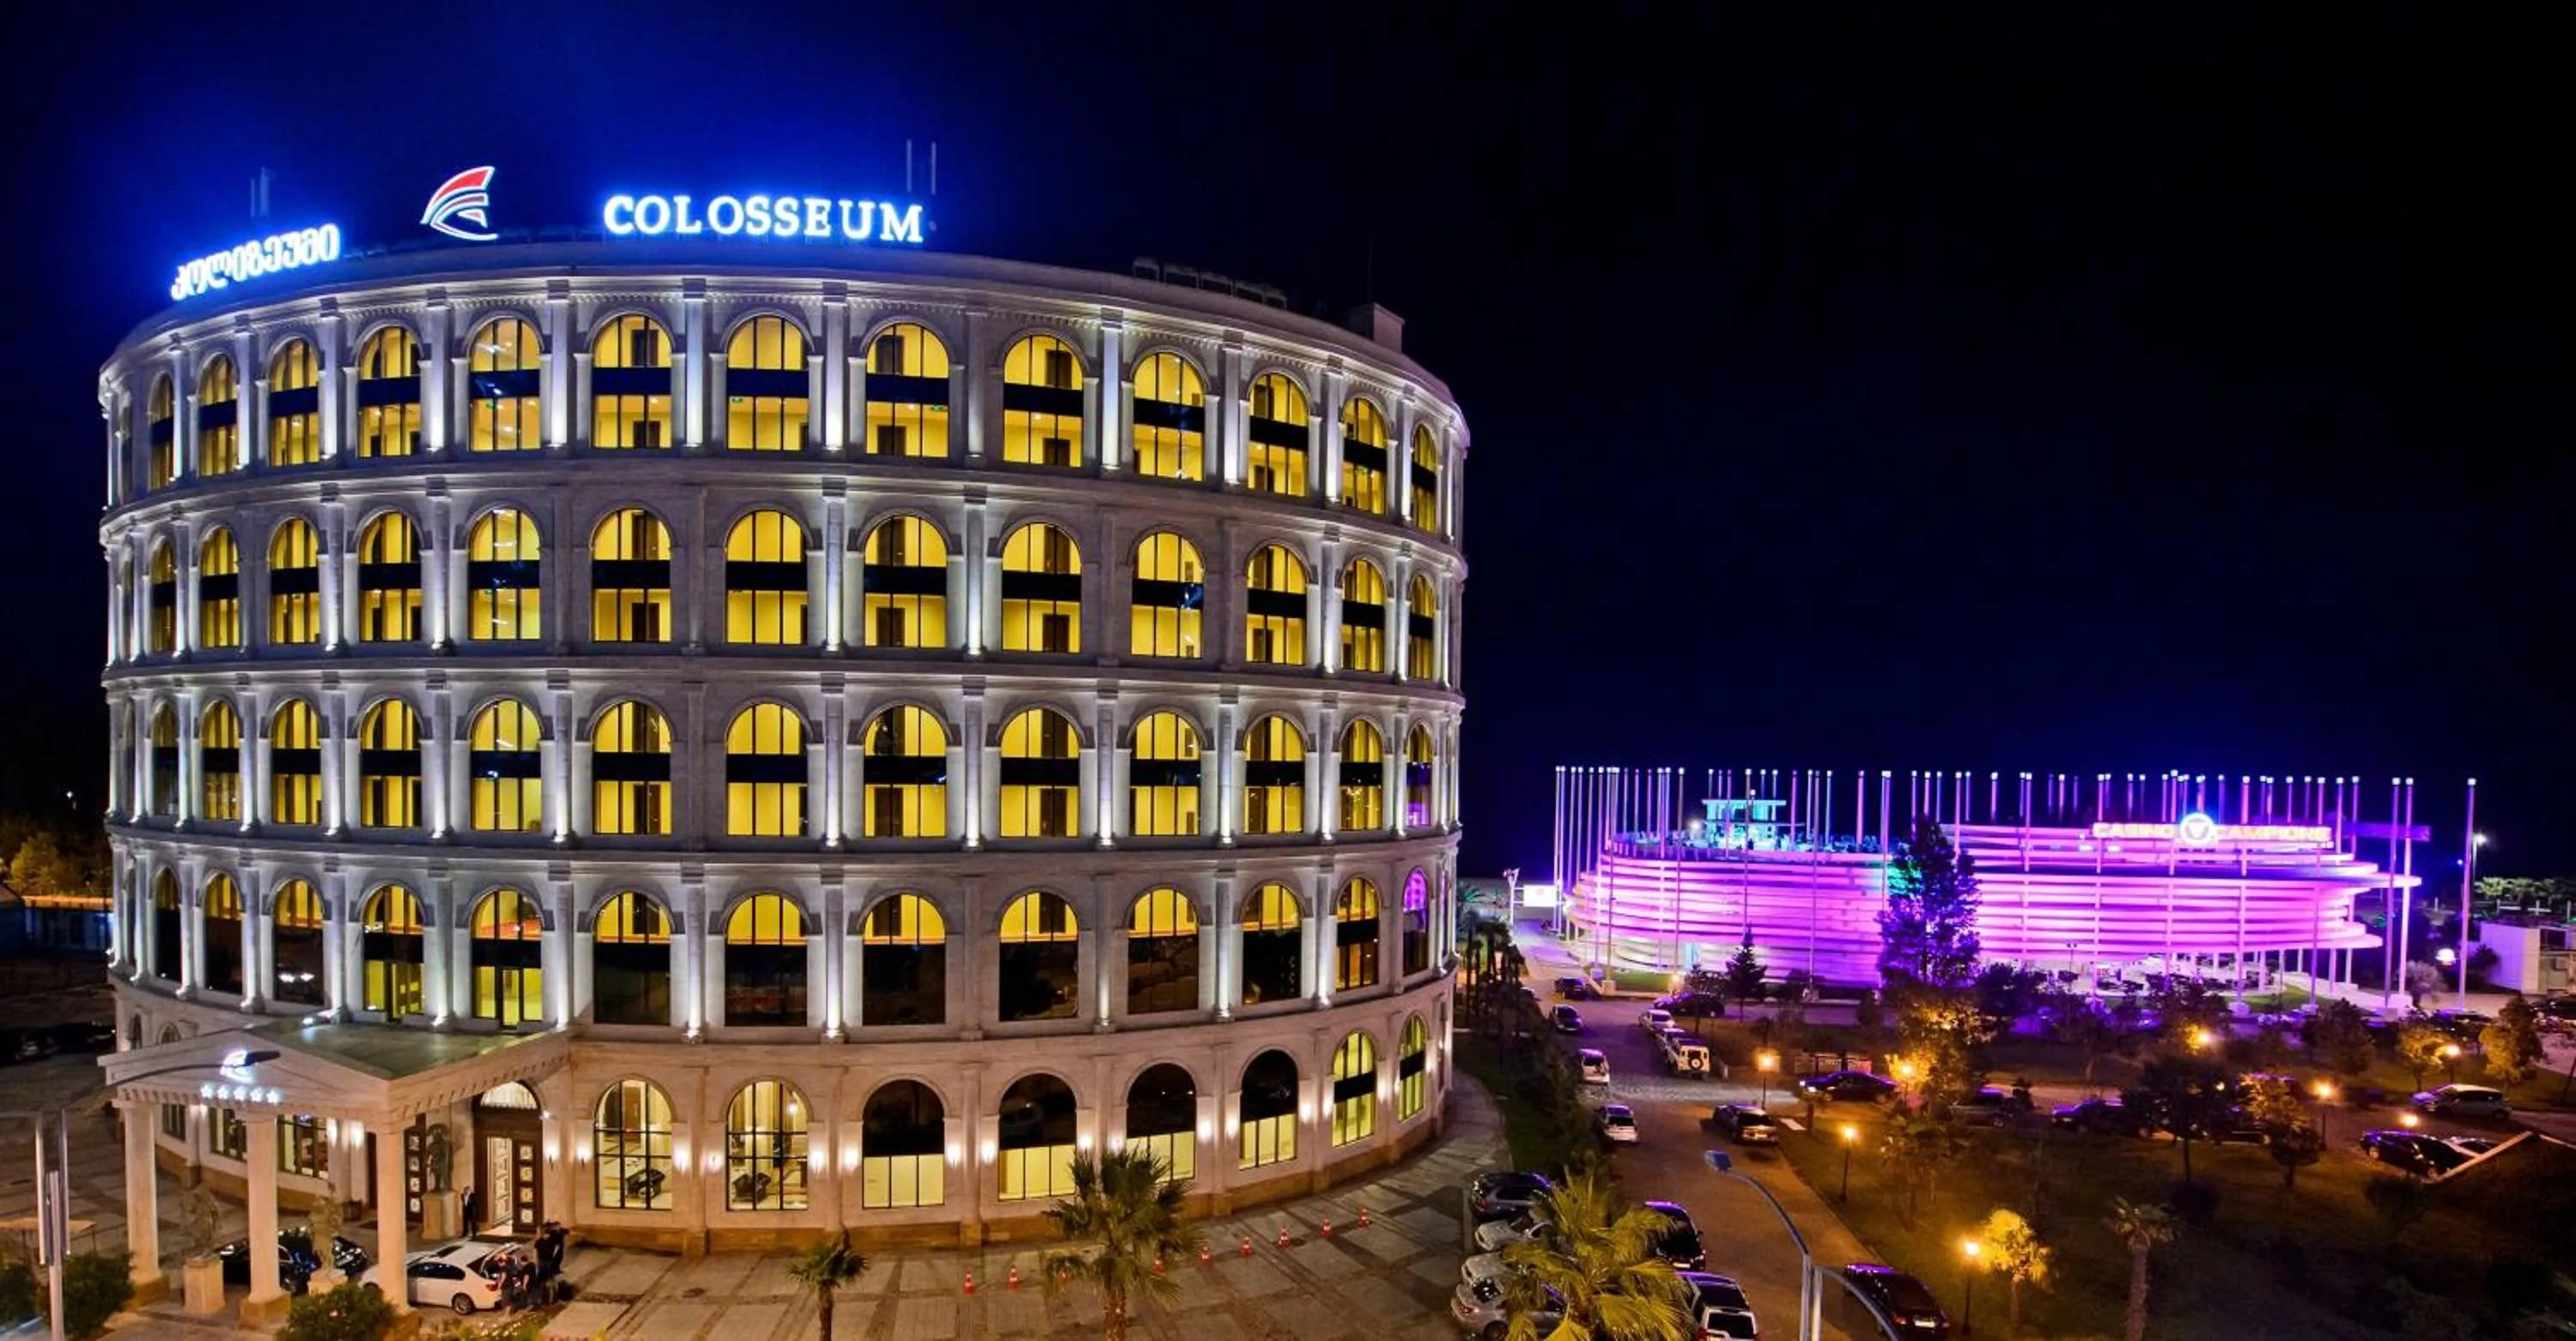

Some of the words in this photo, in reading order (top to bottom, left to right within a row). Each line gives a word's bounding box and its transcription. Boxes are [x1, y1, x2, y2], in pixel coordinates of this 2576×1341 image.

[603, 194, 924, 244] COLOSSEUM
[171, 222, 341, 300] კოლიზეუმი
[2093, 823, 2176, 839] CASINO
